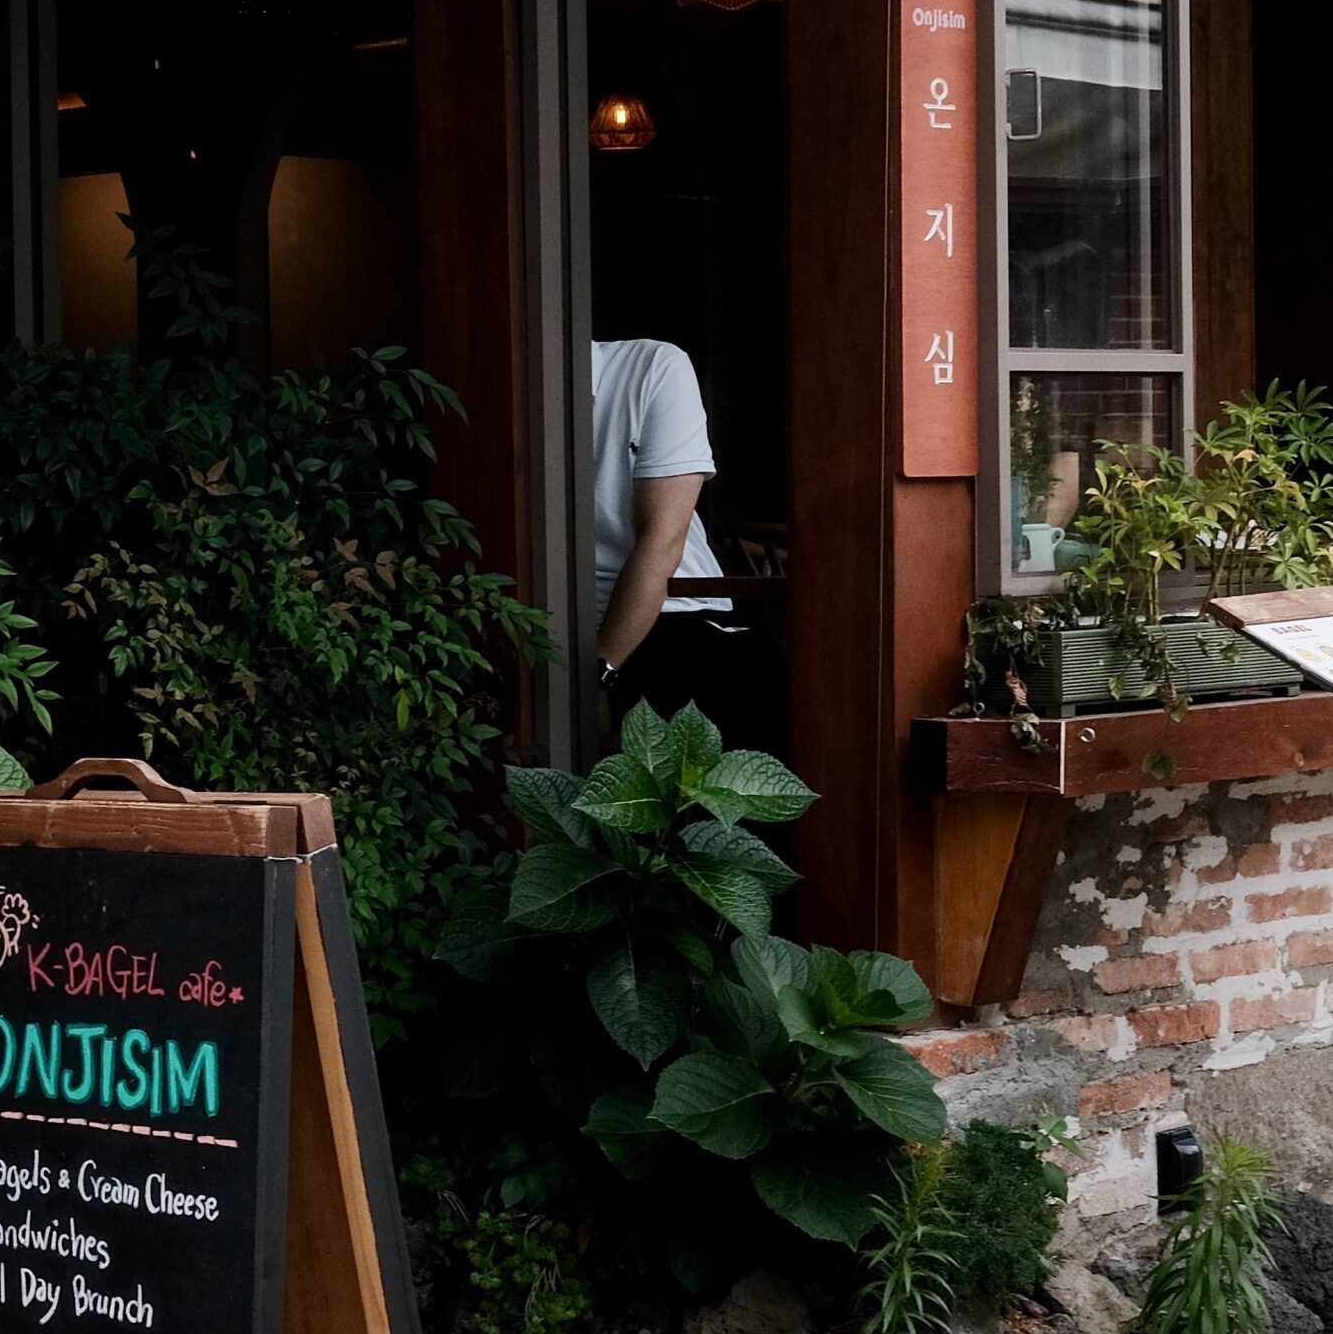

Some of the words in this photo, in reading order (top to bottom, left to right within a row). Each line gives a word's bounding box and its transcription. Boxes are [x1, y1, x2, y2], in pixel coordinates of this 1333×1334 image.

[912, 8, 965, 32] Onjisim
[922, 77, 956, 385] 온지심
[27, 941, 165, 1000] K-BAGEL
[179, 960, 226, 1008] cafe
[59, 1168, 71, 1190] &
[77, 1159, 140, 1209] Cream
[144, 1173, 220, 1222] Cheese
[20, 1267, 61, 1326] Day
[72, 1274, 154, 1329] Brunch
